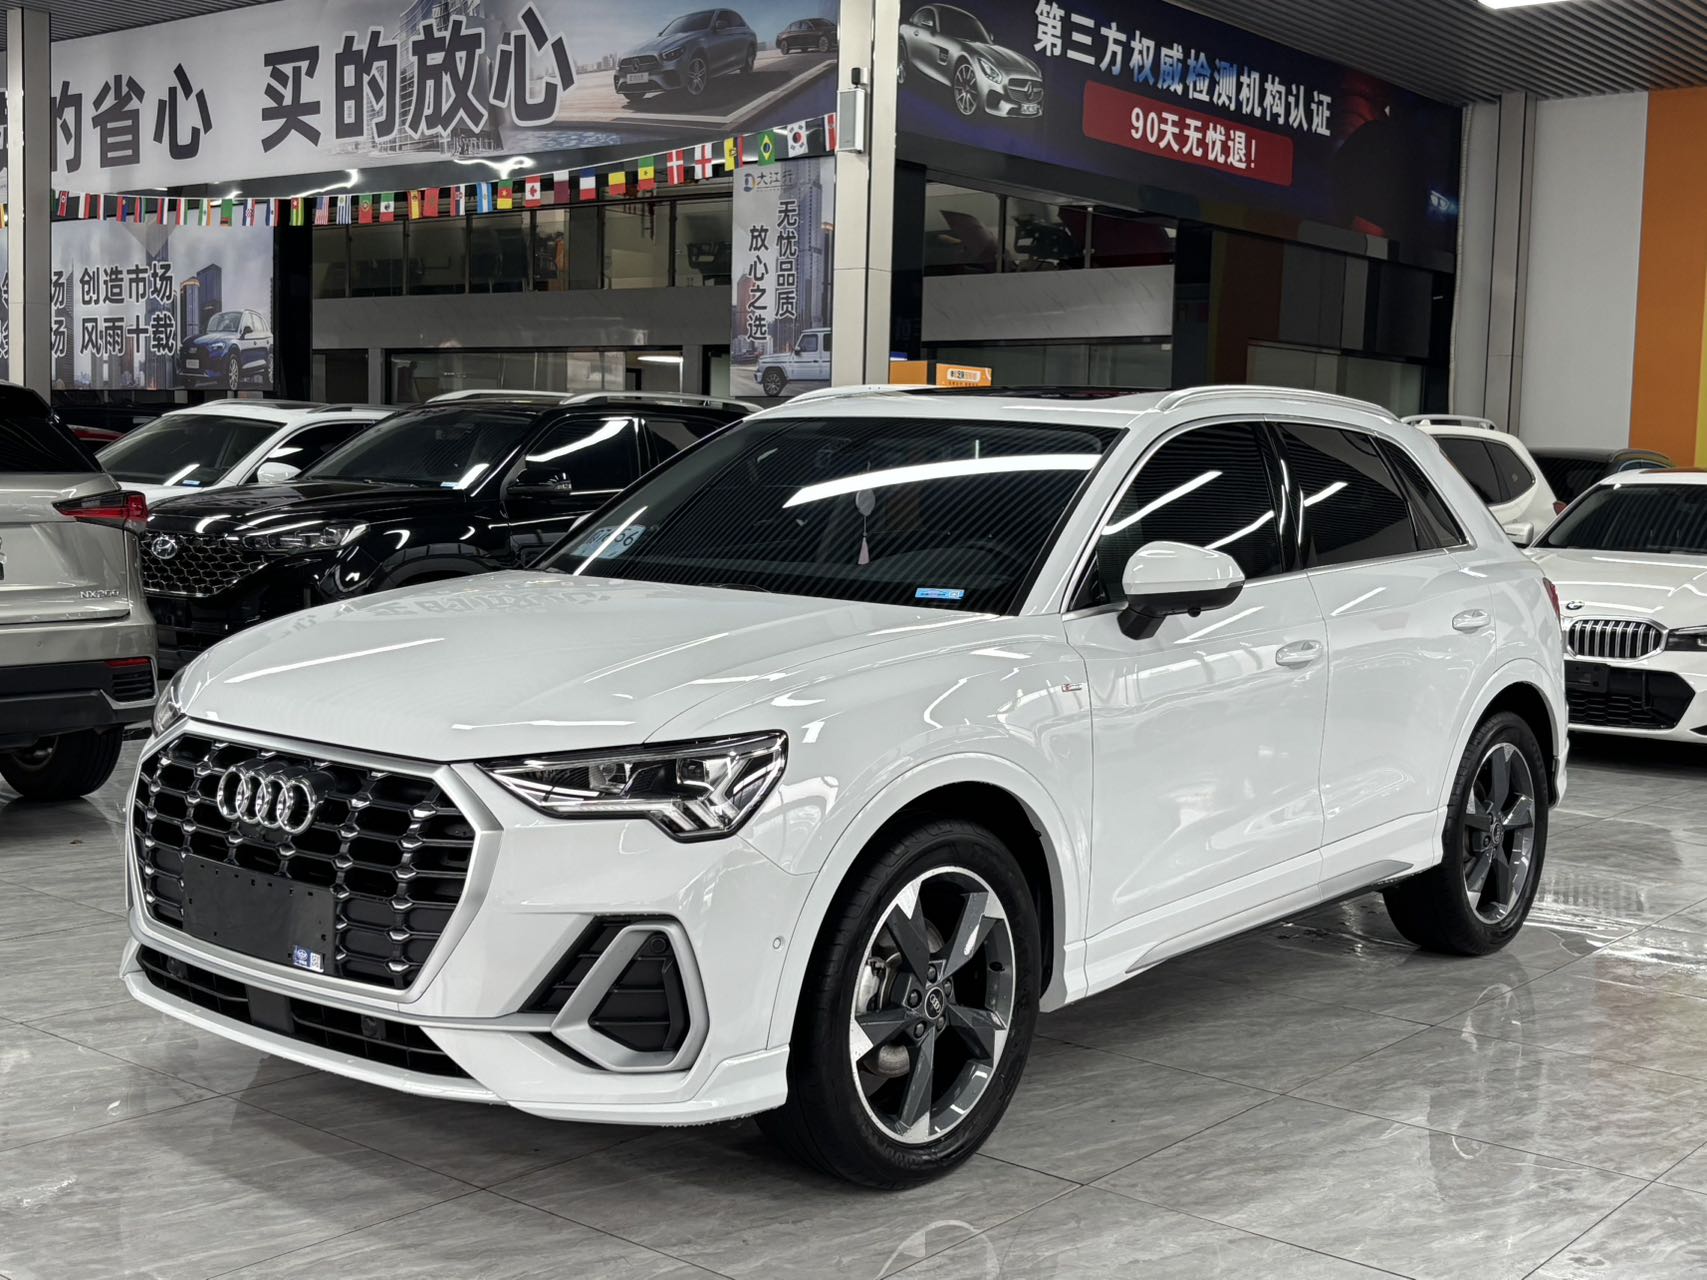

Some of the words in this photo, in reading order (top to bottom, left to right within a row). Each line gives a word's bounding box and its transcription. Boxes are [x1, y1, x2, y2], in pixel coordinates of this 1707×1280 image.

[261, 3, 575, 153] 买的放心
[1033, 0, 1332, 137] 第三方权威检测机构认证
[79, 263, 173, 305] 创造市场
[747, 225, 769, 341] 放心之选
[775, 200, 798, 318] 无忧品质
[80, 313, 174, 356] 风雨十载
